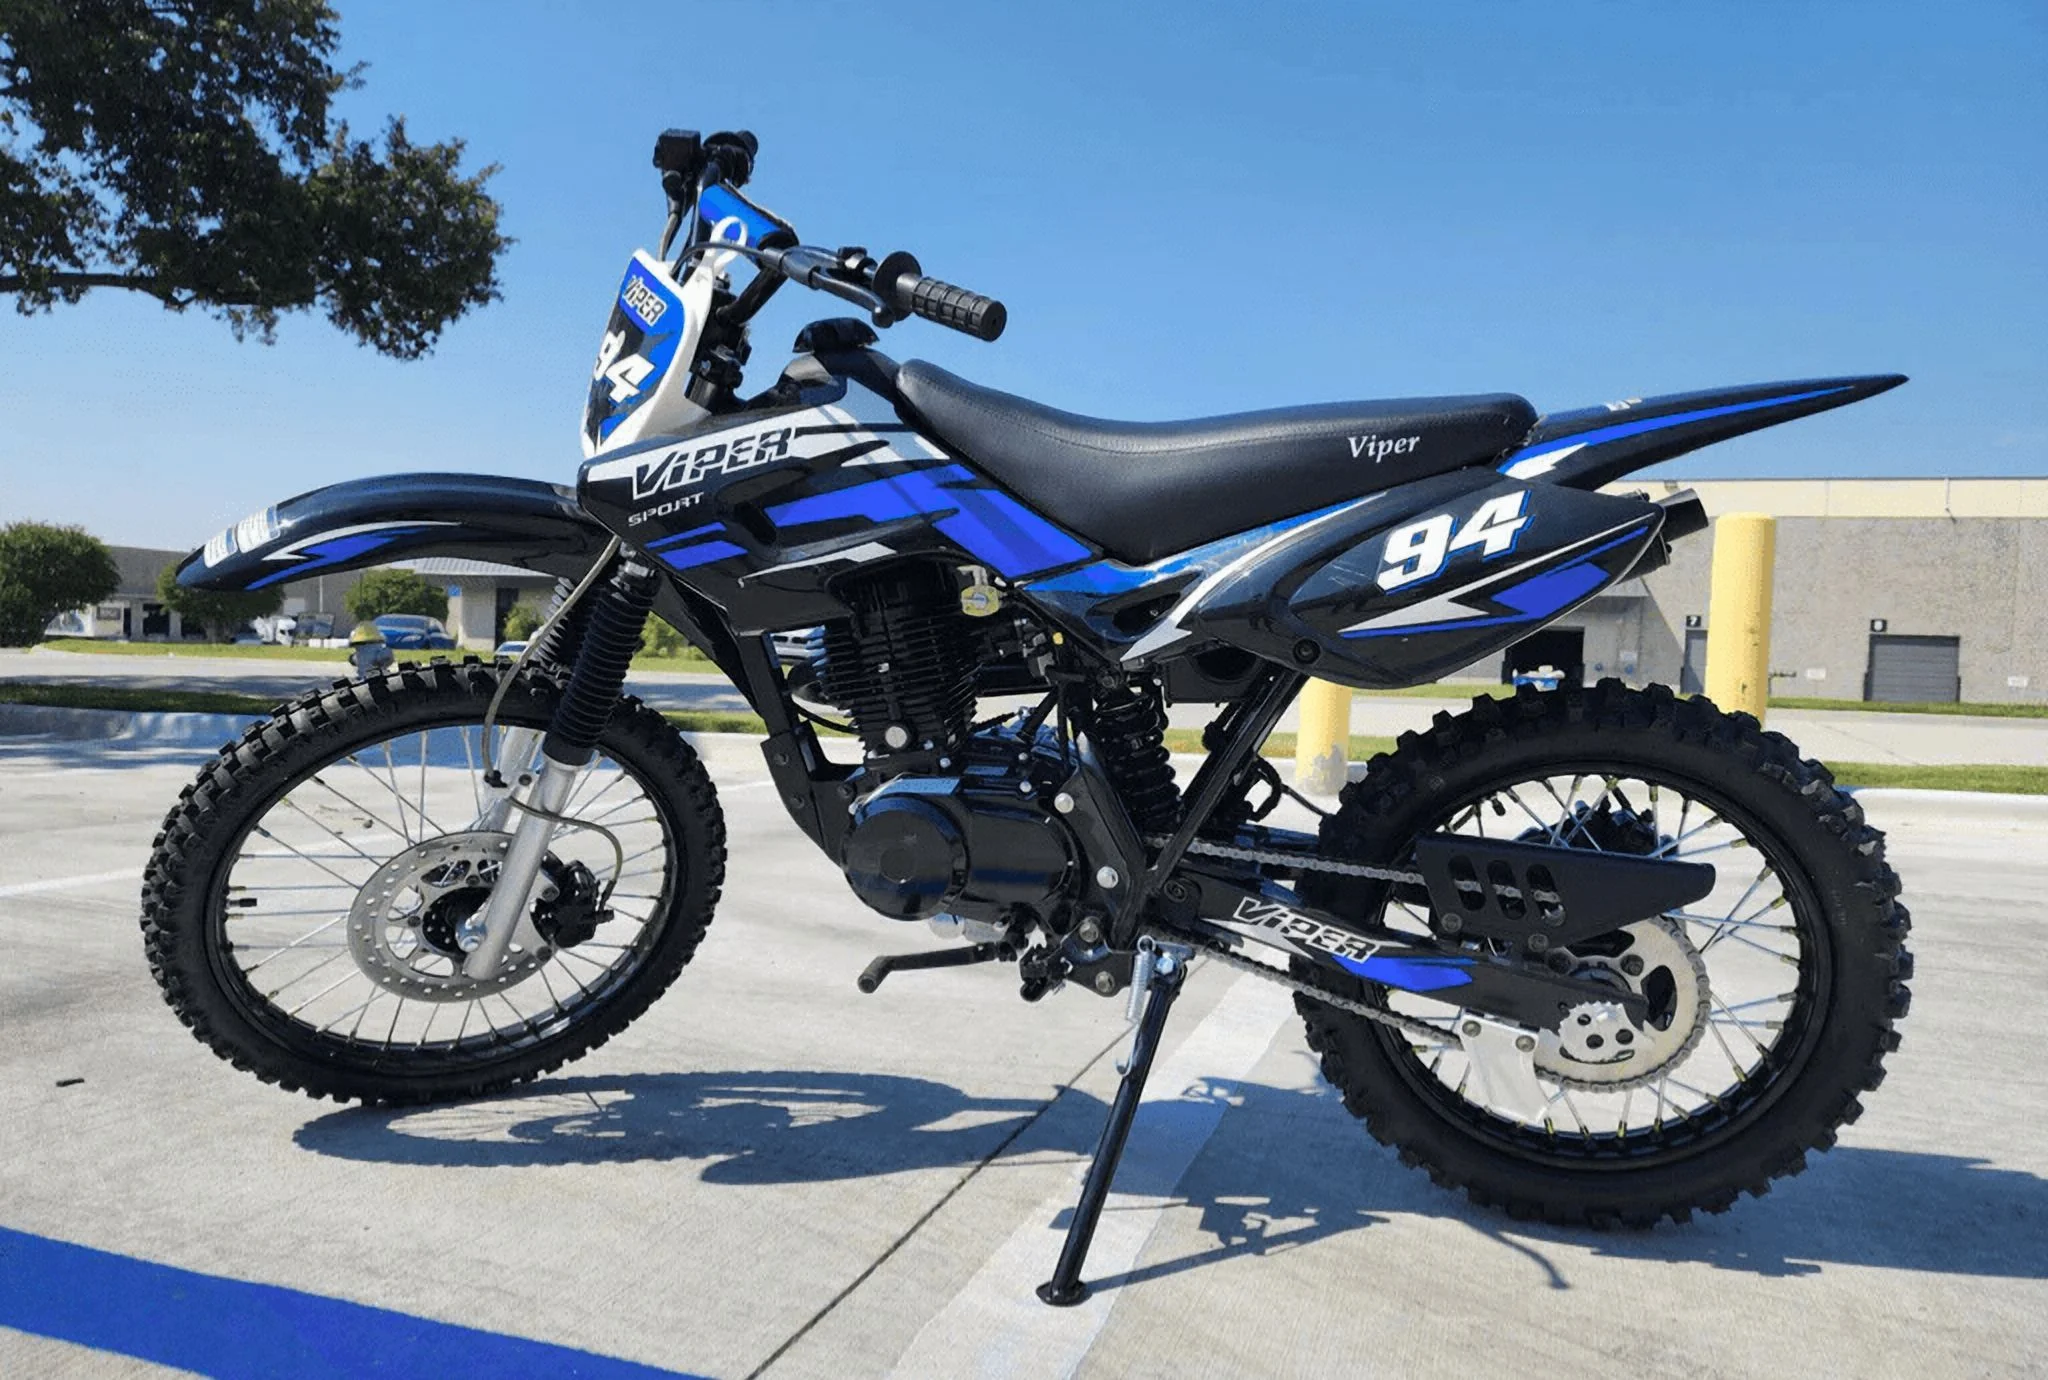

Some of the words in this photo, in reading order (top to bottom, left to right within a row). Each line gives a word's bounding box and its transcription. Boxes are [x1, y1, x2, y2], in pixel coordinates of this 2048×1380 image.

[593, 330, 656, 403] 94
[1348, 435, 1420, 463] Viper
[628, 492, 704, 527] SPORT
[1376, 489, 1532, 594] 94
